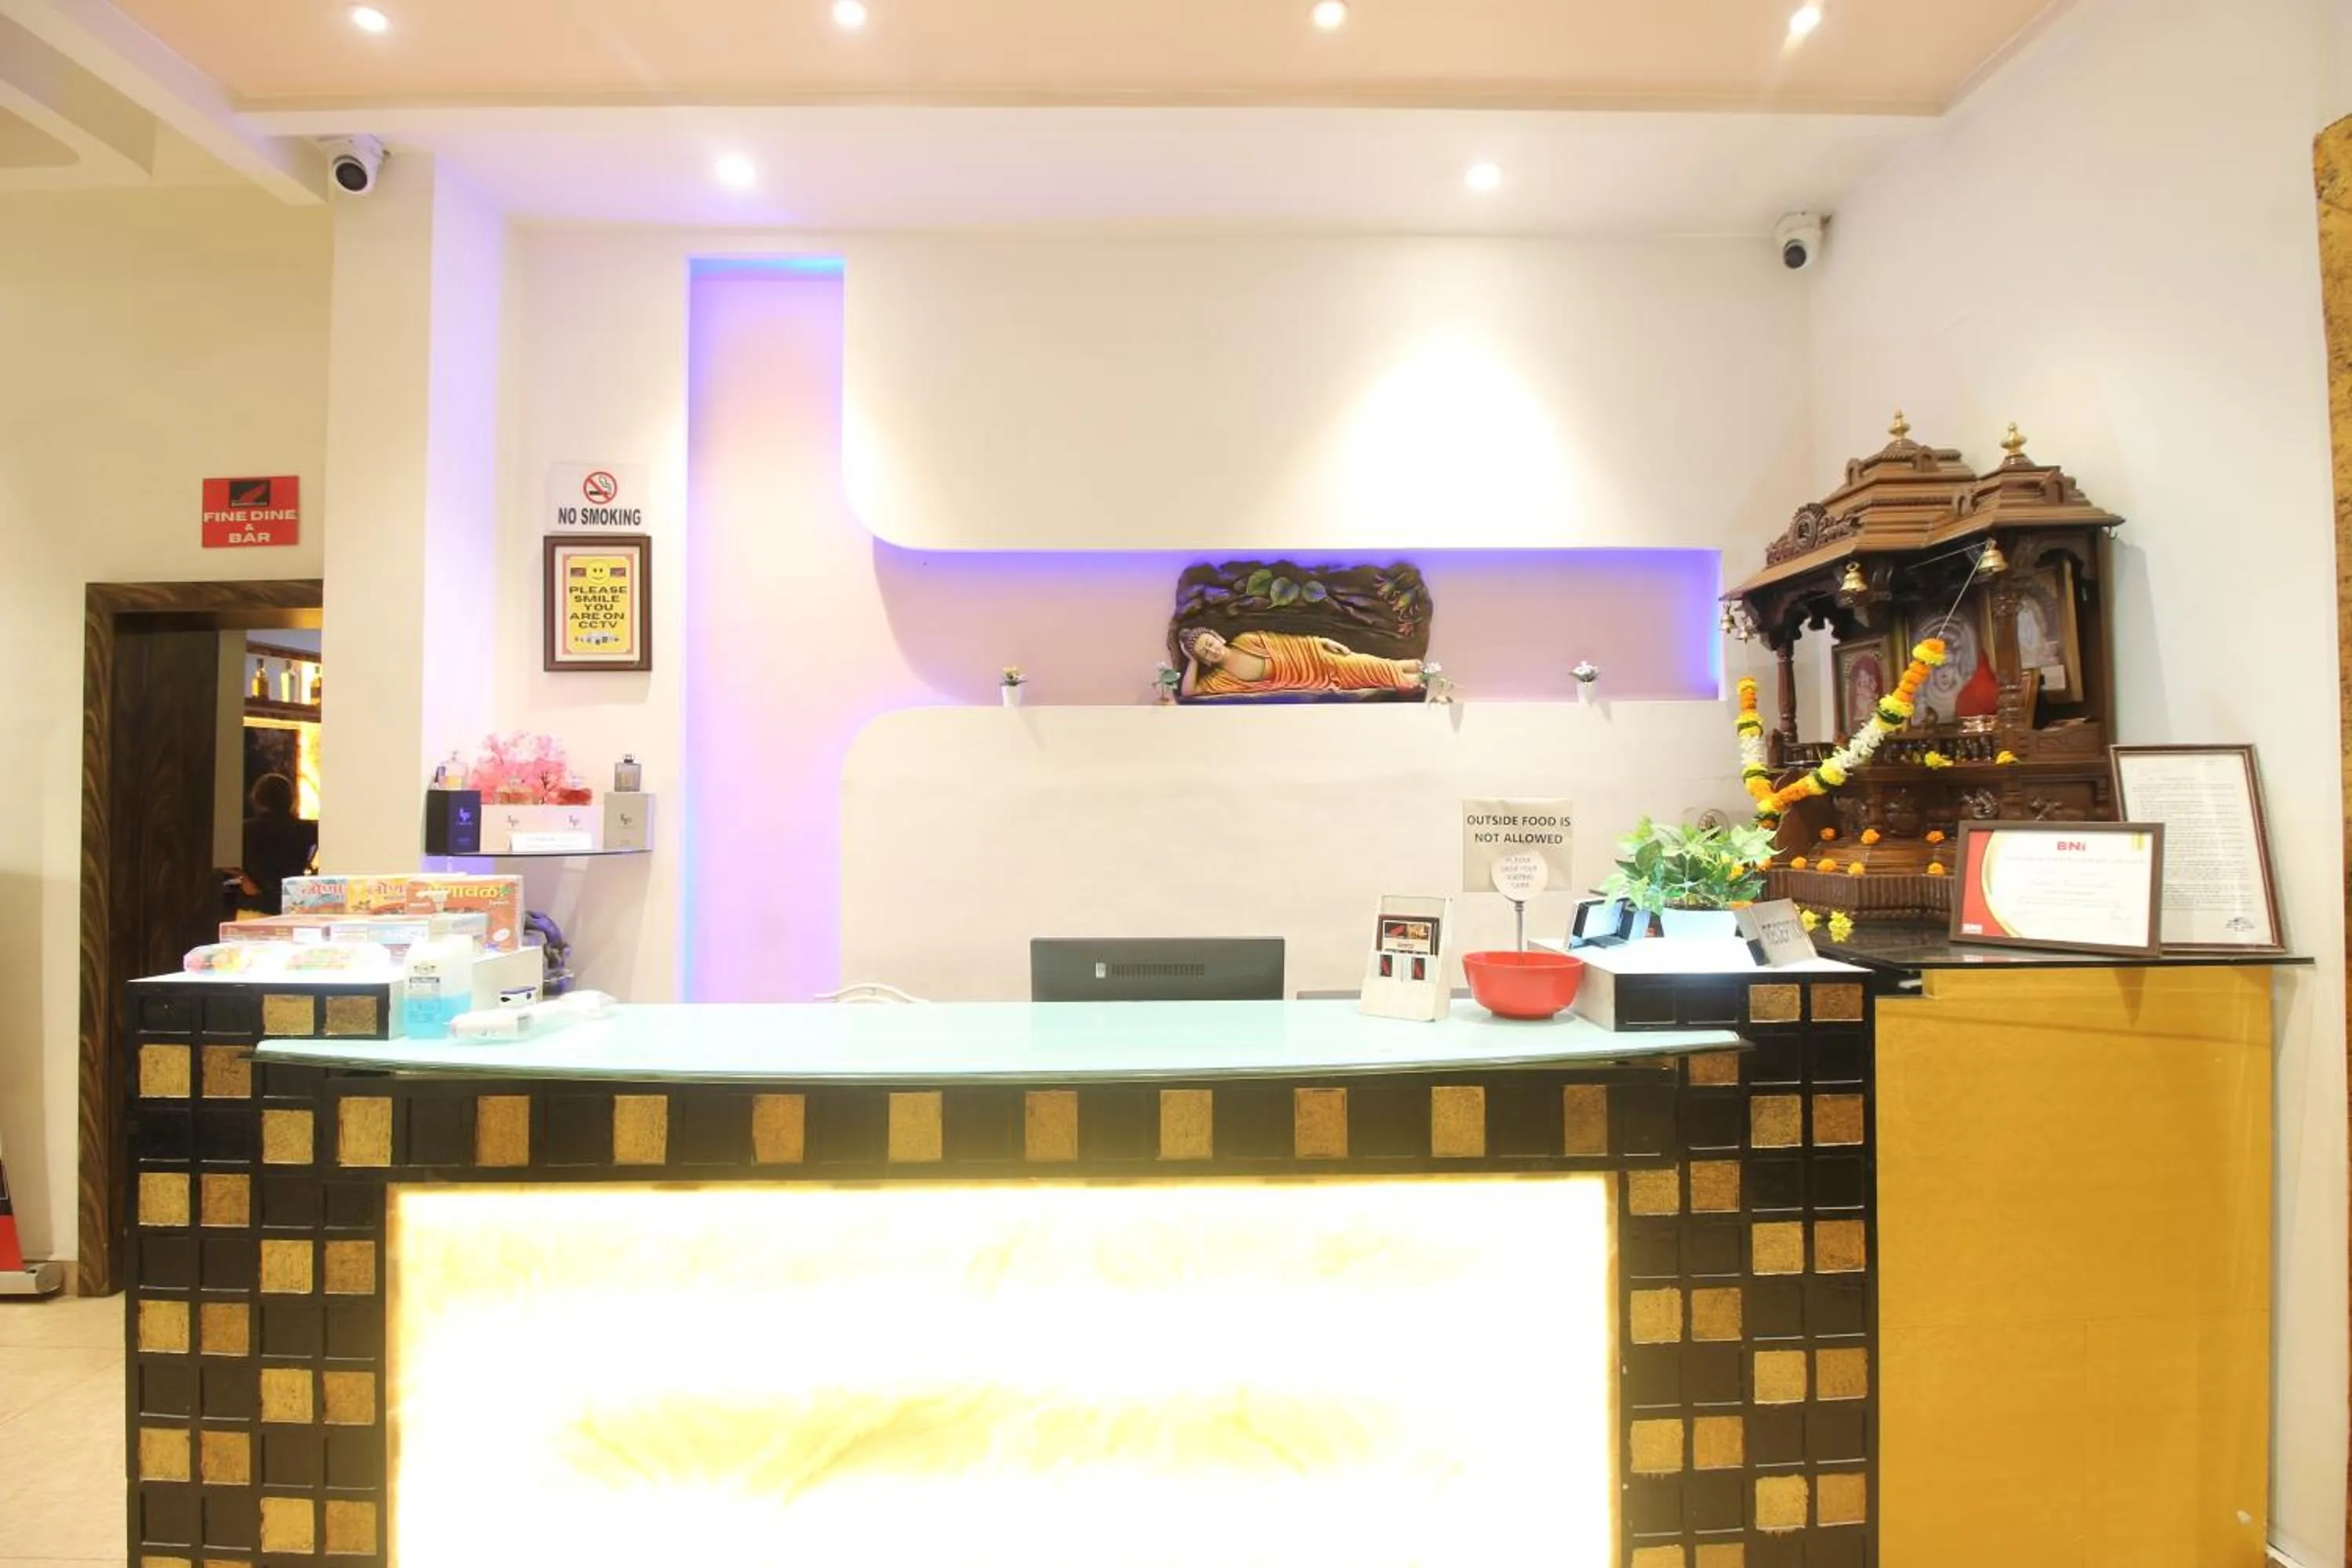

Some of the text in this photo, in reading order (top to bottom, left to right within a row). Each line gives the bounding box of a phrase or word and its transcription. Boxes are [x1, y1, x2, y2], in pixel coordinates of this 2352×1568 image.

[203, 510, 298, 523] FINE DINE
[558, 508, 641, 526] NO SMOKING
[228, 532, 271, 543] BAR
[568, 586, 627, 594] PLEASE
[1467, 815, 1571, 827] OUTSIDE FOOD IS
[1475, 833, 1563, 844] NOT ALLOWED
